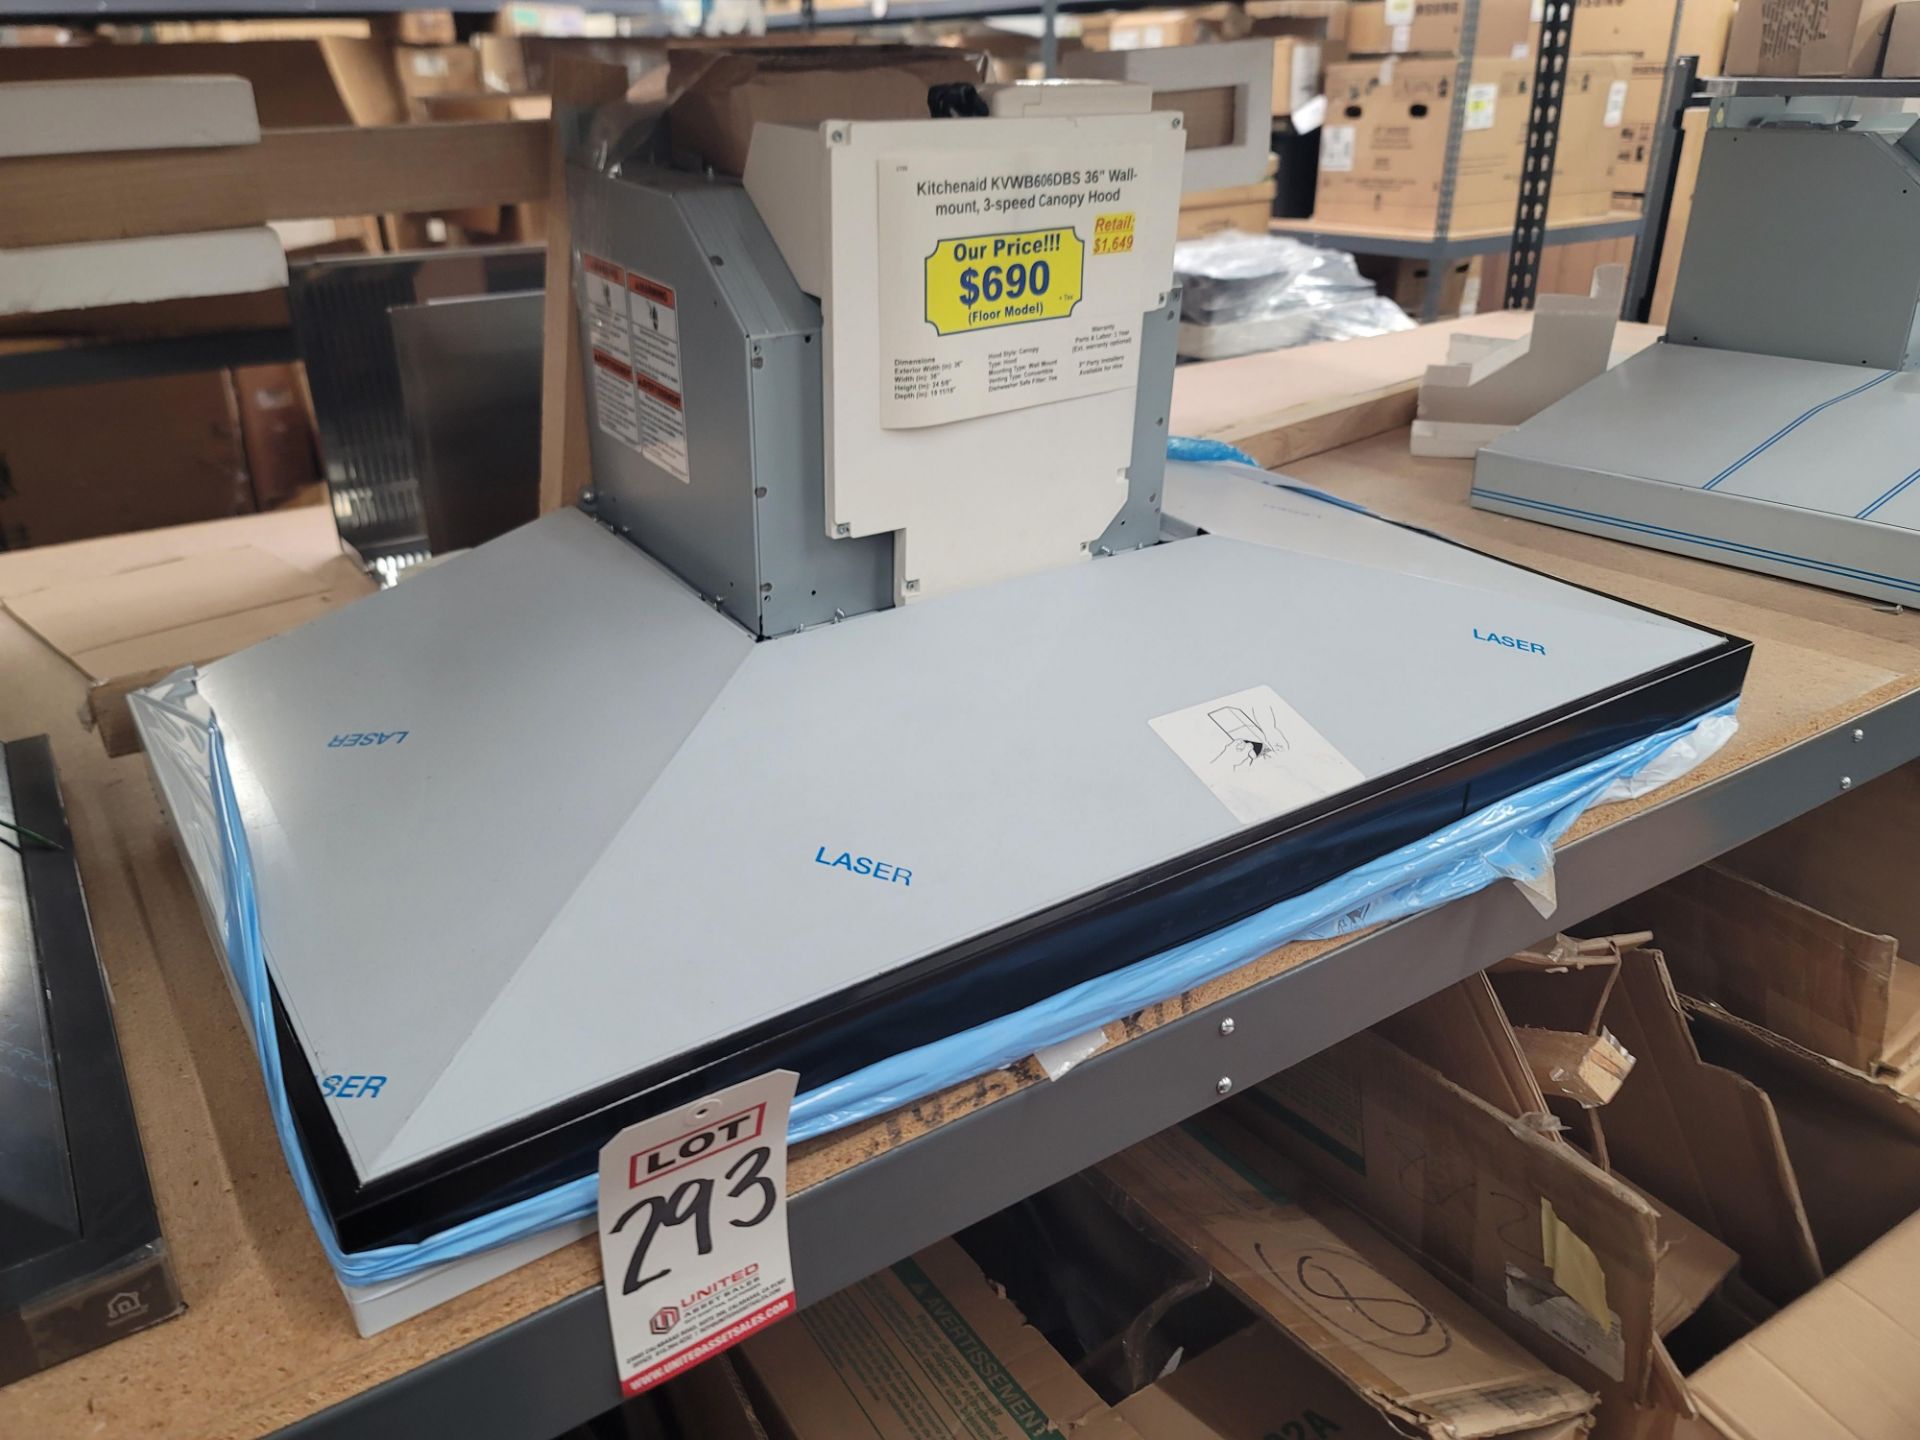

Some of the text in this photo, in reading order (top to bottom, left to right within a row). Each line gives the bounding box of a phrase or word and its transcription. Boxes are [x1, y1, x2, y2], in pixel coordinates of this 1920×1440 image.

[917, 168, 1138, 196] Kitchenaid KVWB606DBS 36" Wall-
[936, 188, 1121, 216] mount, 3-speed Canopy Hood
[1094, 215, 1136, 233] Retail:
[953, 233, 1061, 263] Our Price!!!
[1093, 235, 1134, 254] $1,649
[959, 260, 1050, 309] $690
[967, 302, 1044, 326] (Floor Model)
[894, 367, 921, 375] Exterior
[1473, 628, 1546, 656] LASER
[328, 730, 409, 747] LASER
[815, 846, 912, 886] LASER
[321, 1074, 387, 1098] SER
[647, 1114, 751, 1175] LOT
[608, 1146, 777, 1296] 293
[681, 1263, 760, 1308] UNITED
[1263, 1409, 1343, 1440] 2A
